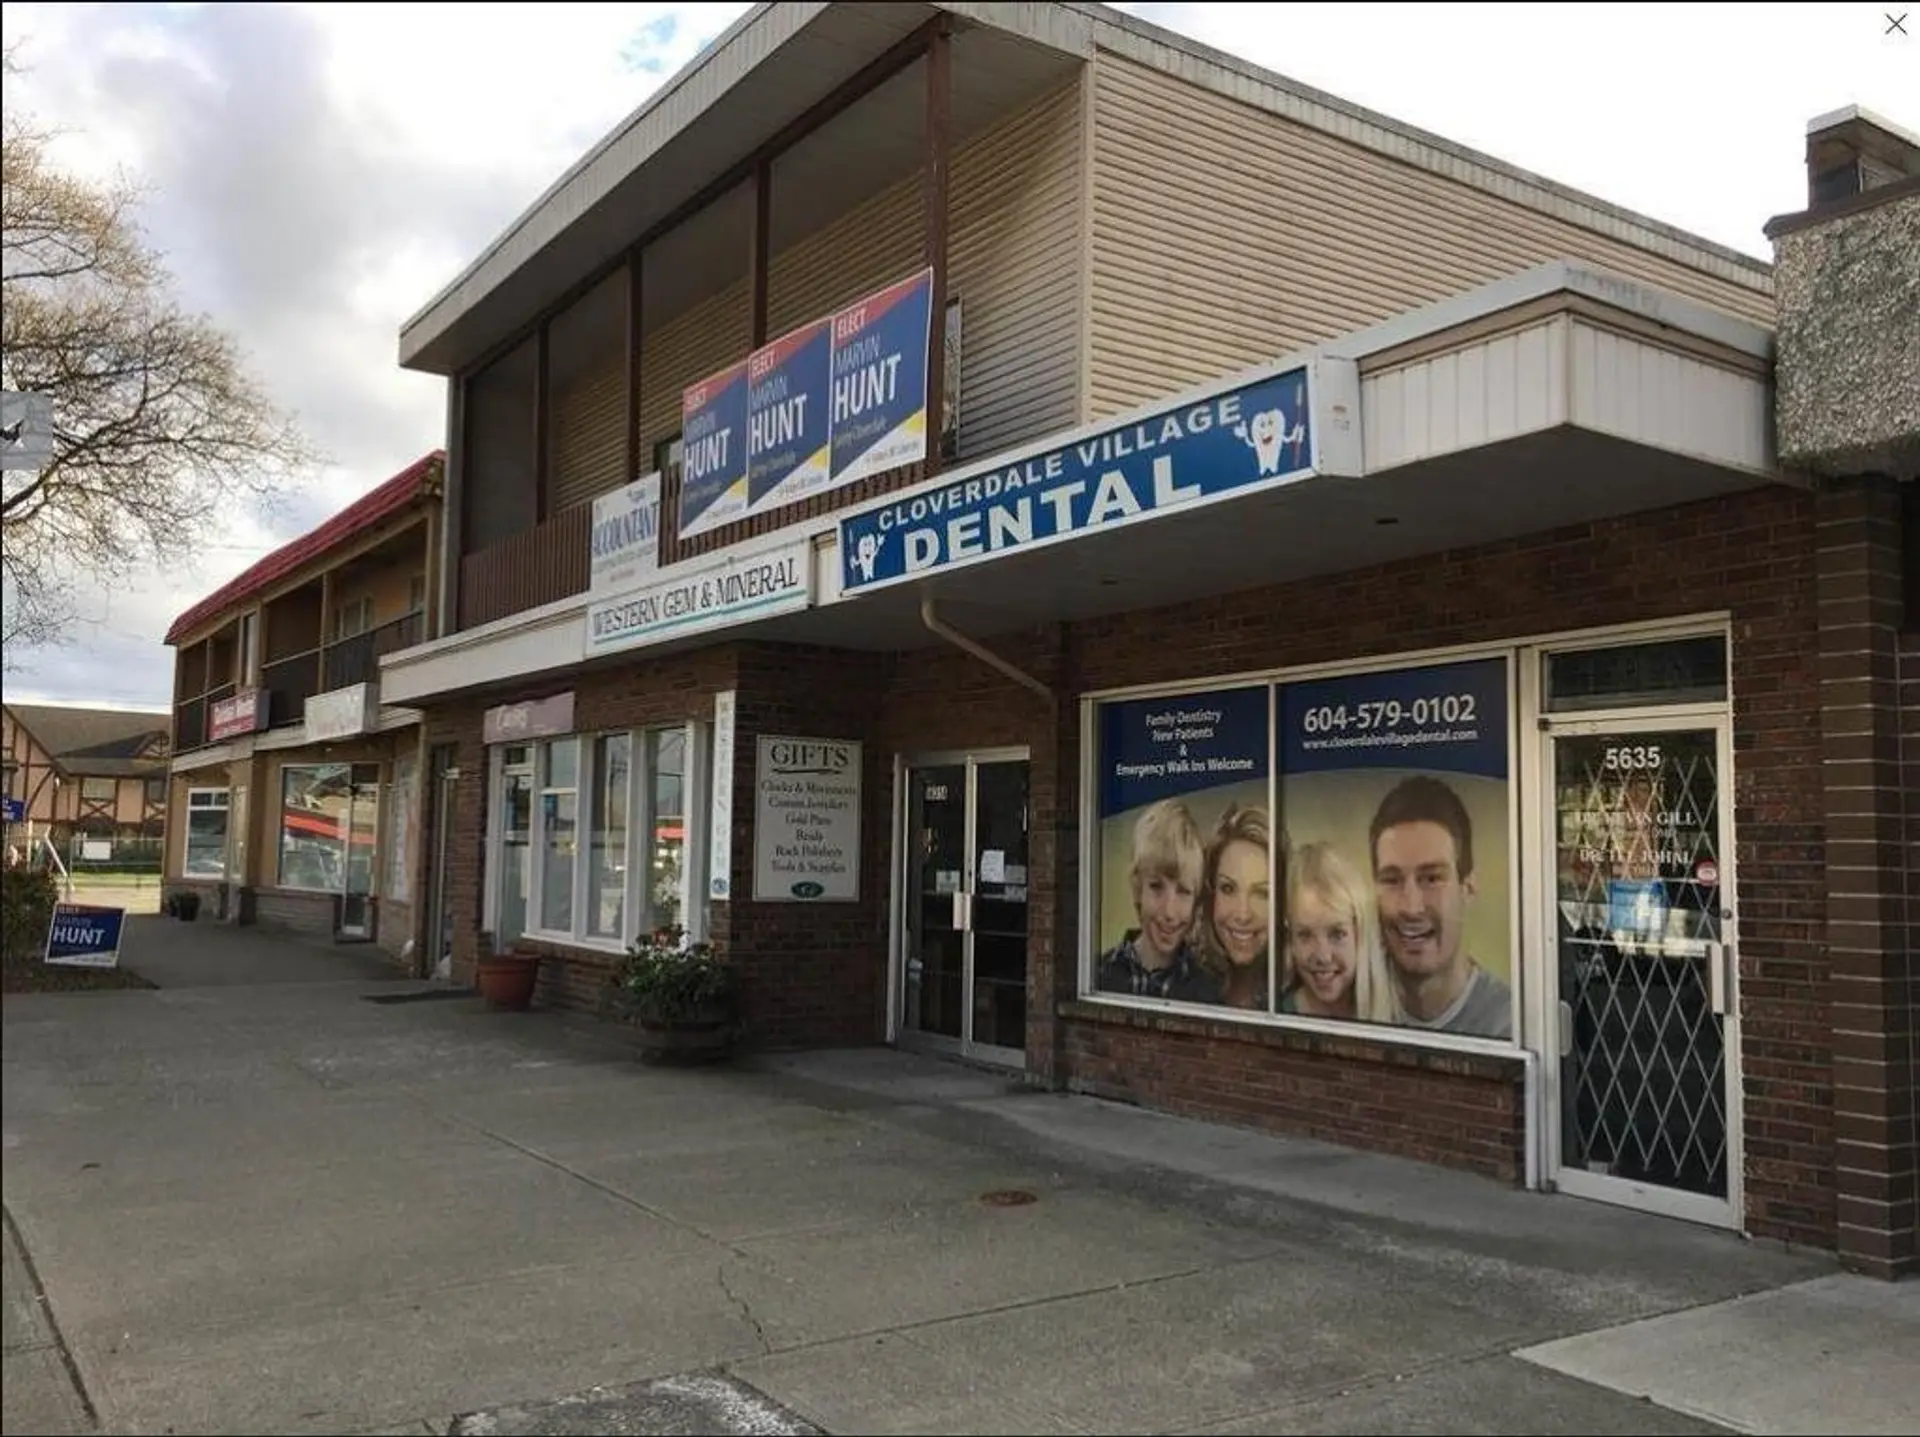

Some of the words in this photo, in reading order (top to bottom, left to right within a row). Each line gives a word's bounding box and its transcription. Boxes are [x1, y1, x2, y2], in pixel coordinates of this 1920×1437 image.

[838, 308, 867, 340] ELECT
[752, 349, 776, 378] ELECT
[836, 333, 881, 376] MARVIN
[834, 353, 902, 423] HUNT
[751, 392, 808, 456] HUNT
[684, 427, 731, 483] HUNT
[879, 452, 1064, 531] CLOVERDALE
[1077, 395, 1243, 467] VILLAGE
[904, 455, 1201, 574] DENTAL
[593, 596, 661, 637] WESTERN
[663, 585, 697, 618] GEM
[699, 581, 714, 608] &
[715, 557, 800, 607] MINERAL
[1146, 712, 1176, 728] Family
[1177, 708, 1222, 724] Dentistry
[1304, 694, 1476, 732] 604-579-0102
[1153, 729, 1174, 742] New
[1175, 727, 1215, 740] Patients
[771, 743, 849, 768] GIFTS
[1116, 762, 1165, 778] Emergency
[1167, 759, 1190, 774] Walk
[1191, 759, 1206, 772] Ins
[1207, 756, 1255, 771] Welcome
[1605, 746, 1661, 770] 5635
[53, 926, 106, 945] HUNT
